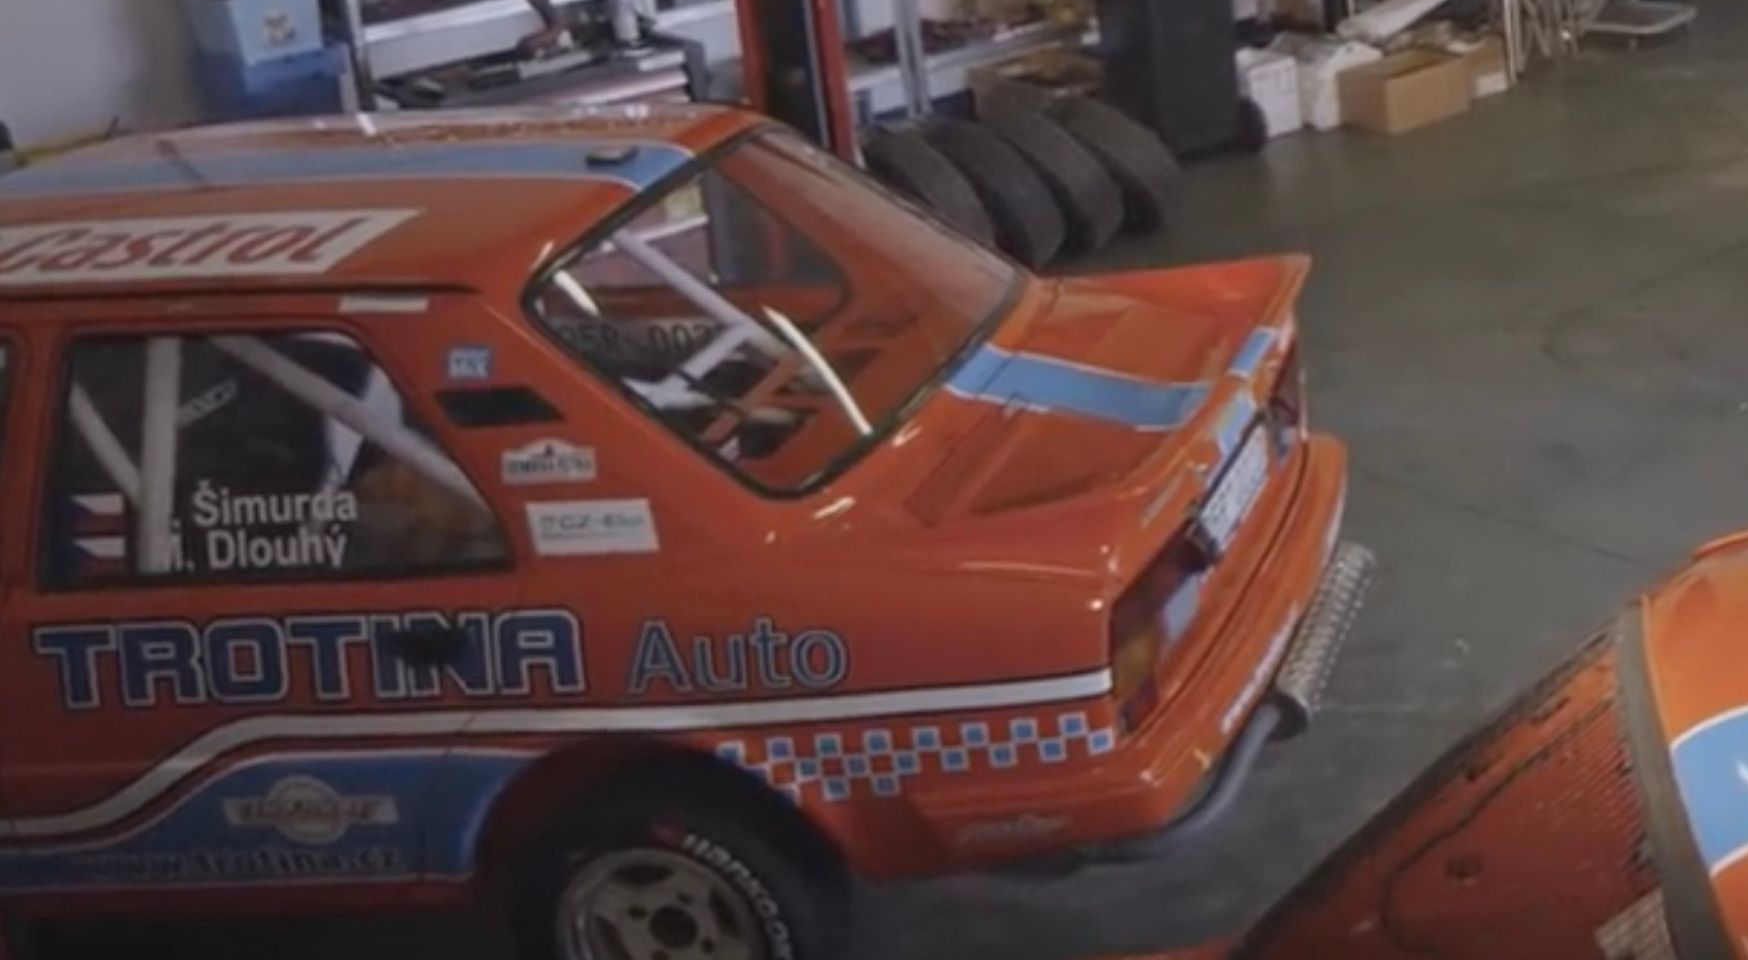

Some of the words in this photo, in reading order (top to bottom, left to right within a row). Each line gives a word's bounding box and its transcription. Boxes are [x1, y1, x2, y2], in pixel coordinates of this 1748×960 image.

[0, 215, 372, 277] Castrol
[192, 478, 358, 527] Šimurda
[206, 524, 347, 570] Dlouhý
[32, 609, 587, 710] TROTINA
[627, 616, 849, 695] Auto
